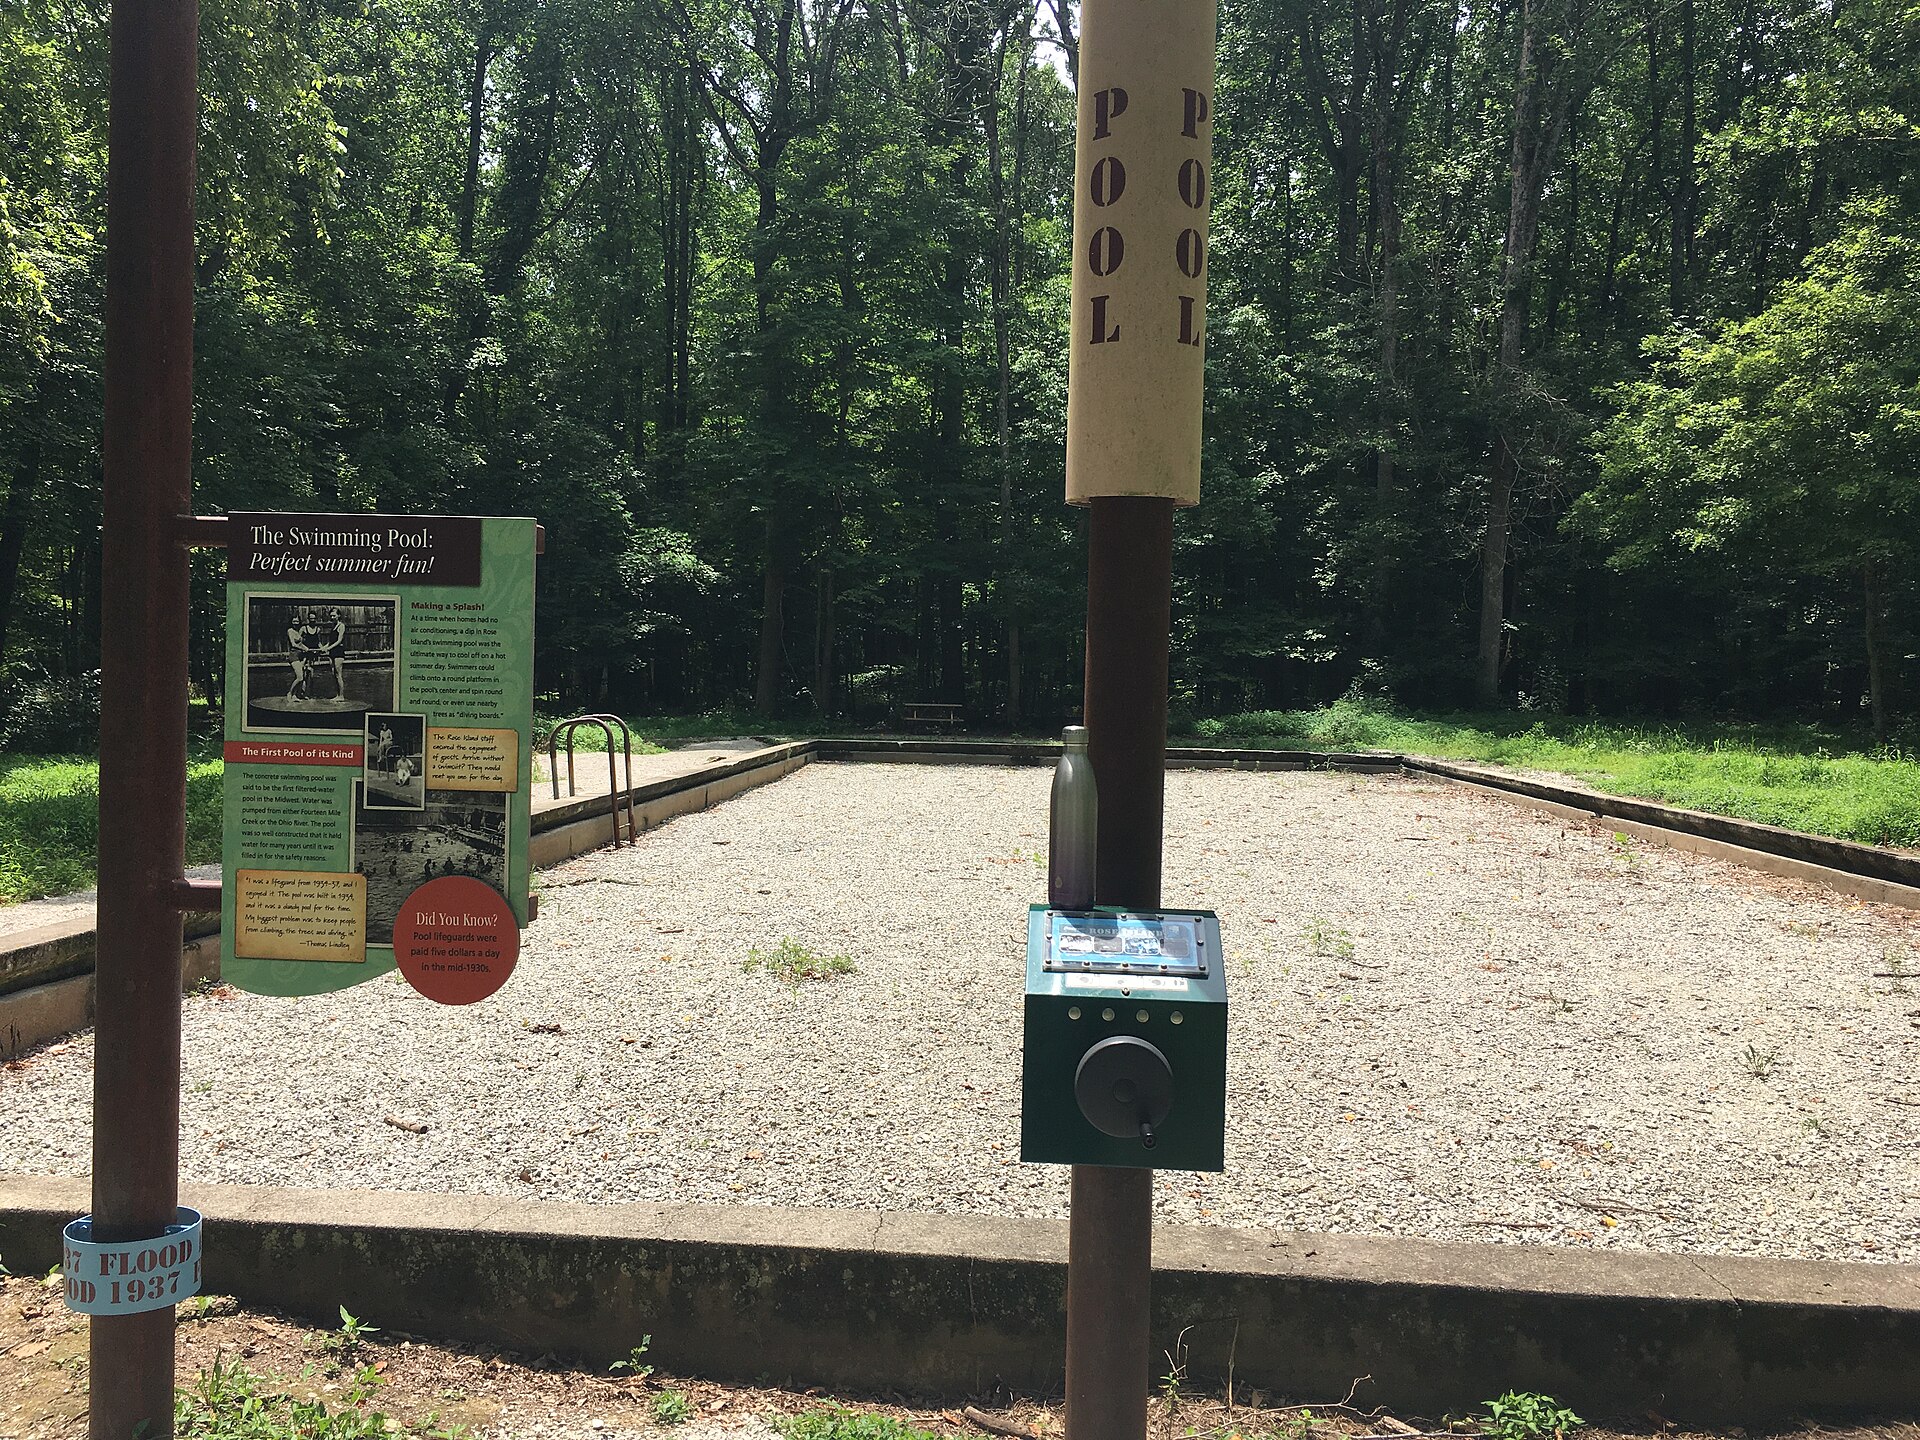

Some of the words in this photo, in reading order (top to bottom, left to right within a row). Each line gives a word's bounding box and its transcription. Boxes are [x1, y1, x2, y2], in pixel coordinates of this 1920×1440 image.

[1089, 88, 1128, 345] POOL
[1176, 88, 1208, 347] POOL
[250, 525, 283, 545] The
[289, 527, 381, 552] Swimming
[388, 528, 433, 548] Pool:
[250, 552, 311, 575] Perfect
[316, 557, 392, 573] summer
[391, 554, 435, 578] fun!
[411, 602, 443, 611] Making
[453, 603, 484, 611] Splash!
[261, 748, 281, 756] First
[284, 749, 303, 757] Pool
[306, 749, 316, 757] of
[333, 750, 353, 758] Kind
[416, 912, 436, 926] Did
[439, 912, 459, 926] You
[463, 913, 498, 927] Know?
[414, 932, 431, 940] Pool
[434, 933, 474, 943] lifeguards
[411, 947, 428, 957] paid
[431, 948, 445, 956] five
[448, 948, 475, 957] dollars
[485, 949, 500, 959] day
[432, 963, 445, 971] the
[448, 964, 491, 973] mid-1930s.
[100, 1239, 192, 1276] FLOOD
[111, 1270, 180, 1304] 1937
